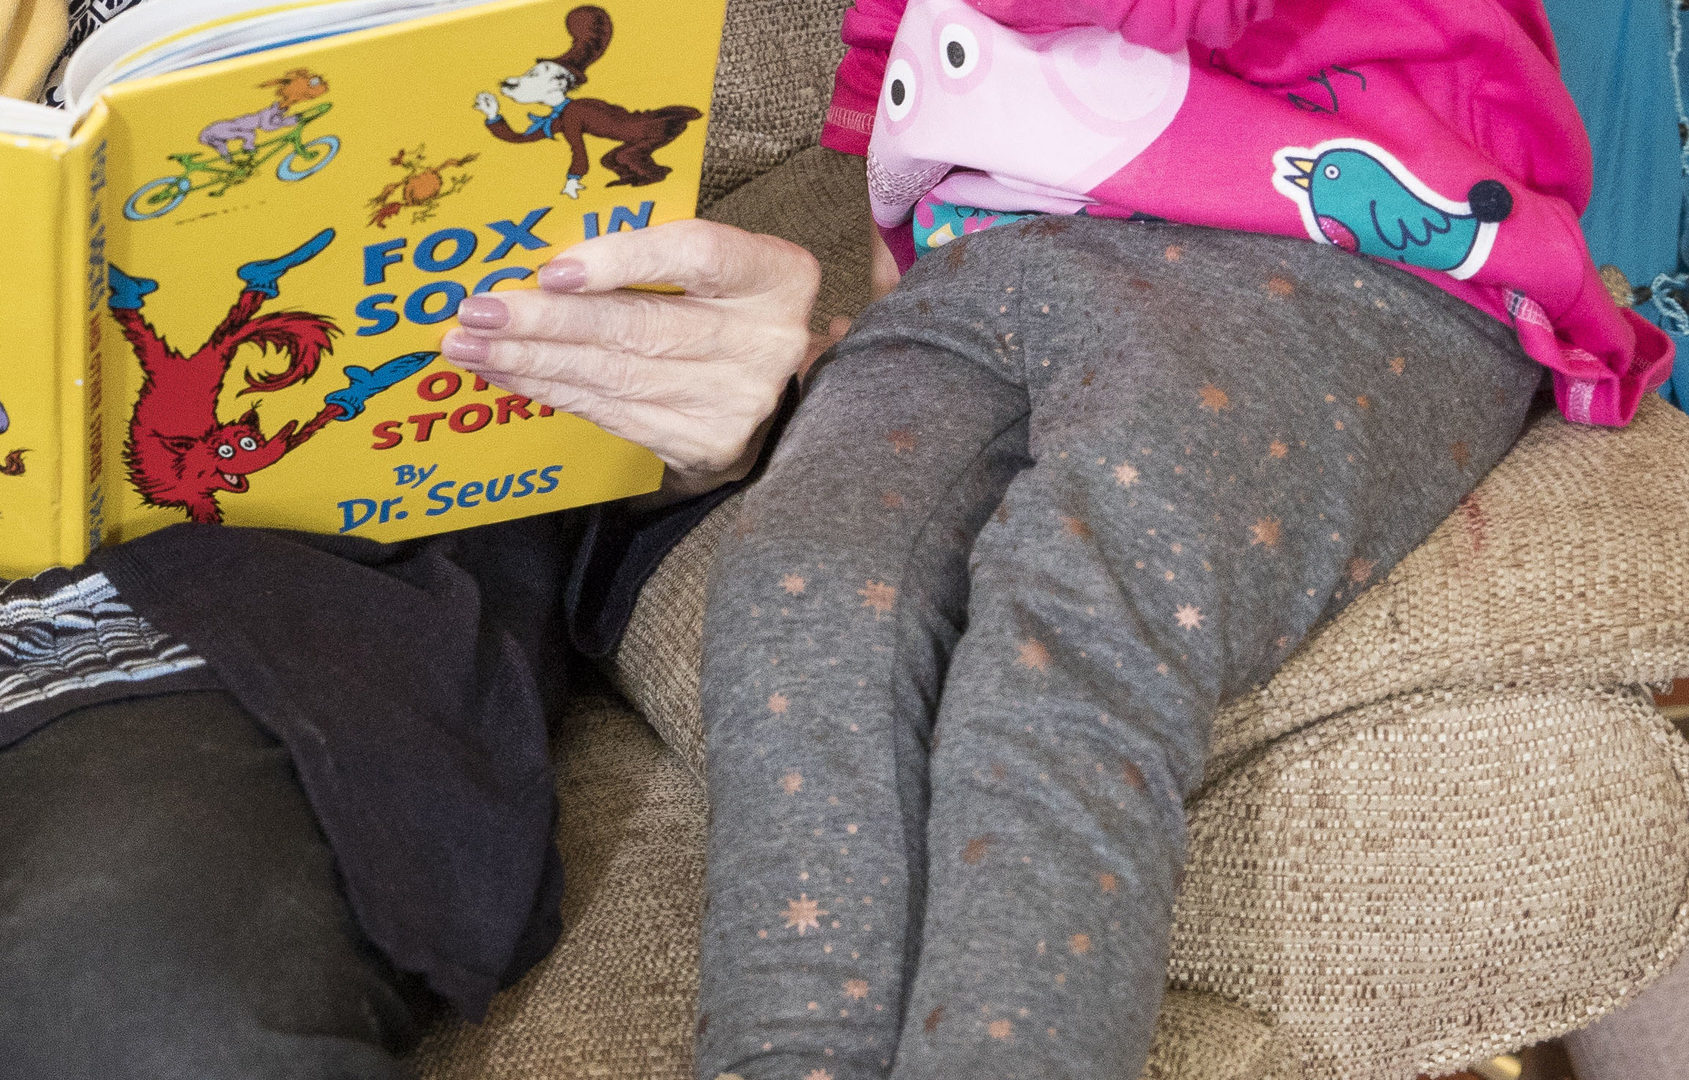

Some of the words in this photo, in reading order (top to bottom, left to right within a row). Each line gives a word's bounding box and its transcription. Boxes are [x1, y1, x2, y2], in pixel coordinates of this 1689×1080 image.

[363, 207, 553, 286] FOX
[583, 201, 655, 240] IN
[355, 267, 534, 336] SOC
[337, 496, 409, 534] Dr.
[425, 465, 563, 516] Seuss
[393, 464, 439, 489] By
